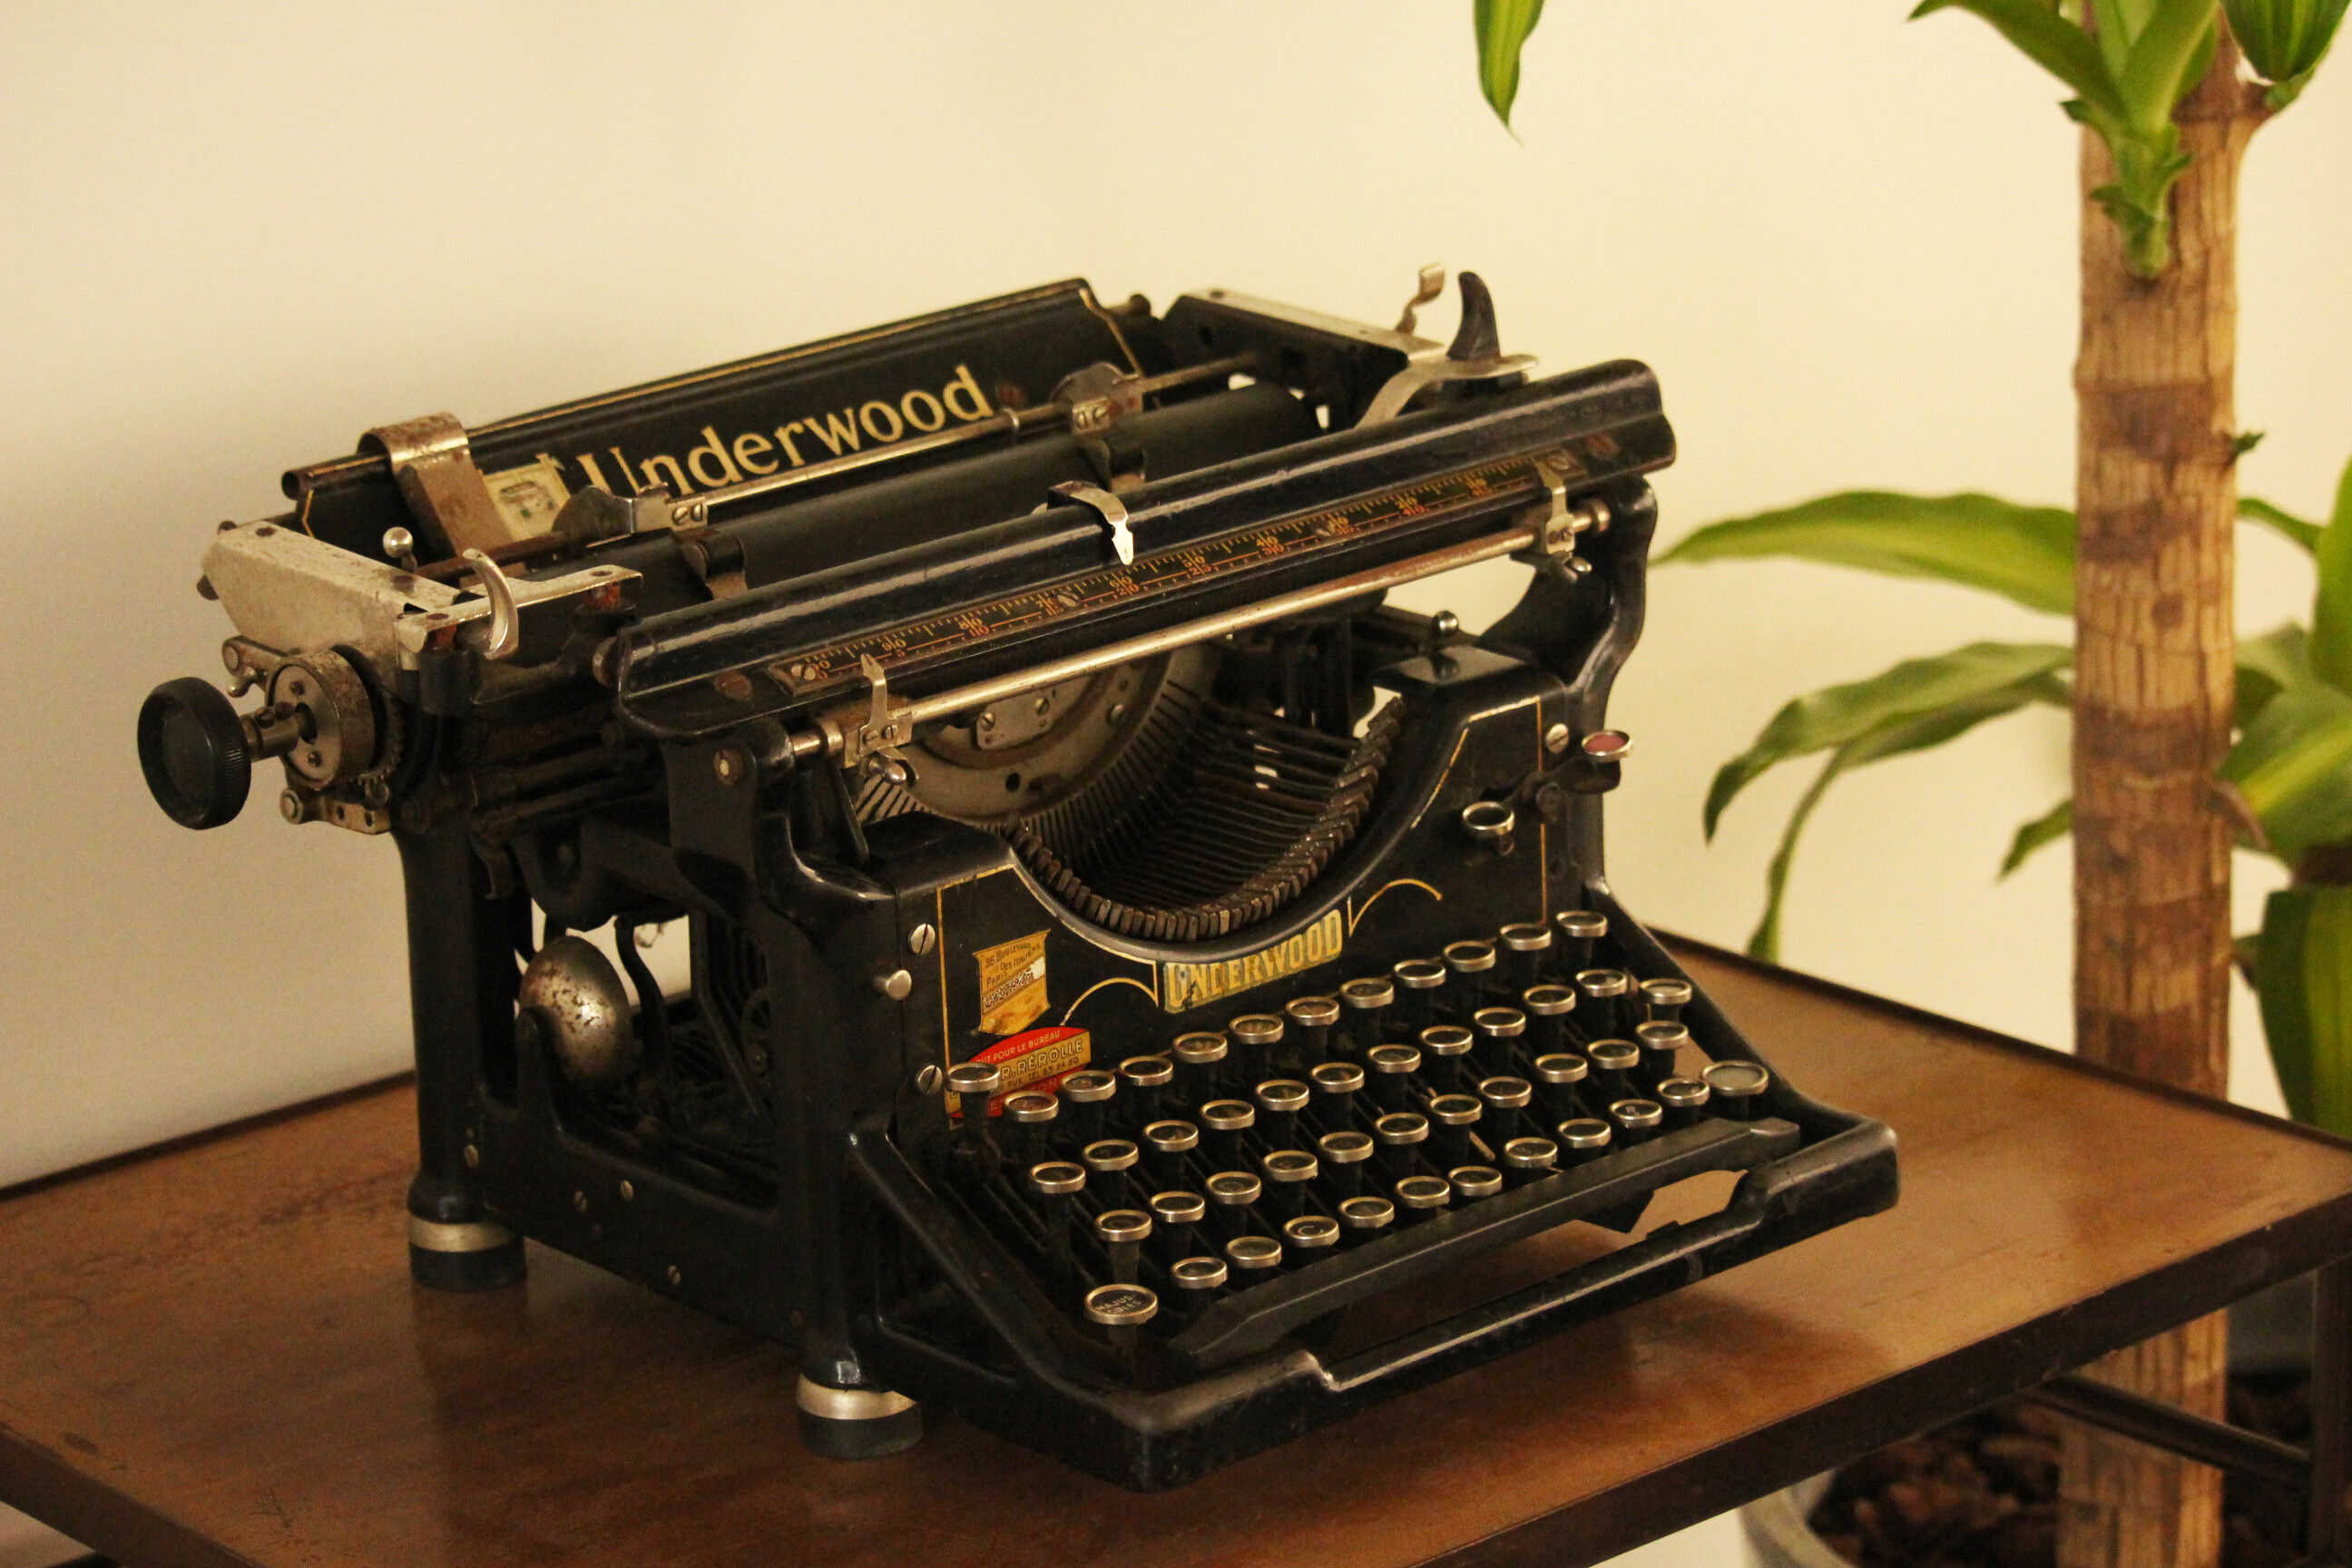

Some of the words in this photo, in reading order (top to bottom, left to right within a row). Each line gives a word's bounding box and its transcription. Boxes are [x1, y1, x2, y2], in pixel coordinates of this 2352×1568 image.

[575, 364, 995, 497] Underwood
[1165, 909, 1343, 1009] UNDERWOOD
[994, 1047, 1015, 1061] POUR
[1017, 1043, 1026, 1053] LE
[1028, 1030, 1060, 1048] BUREAU
[1017, 1037, 1084, 1074] RÉROLLE
